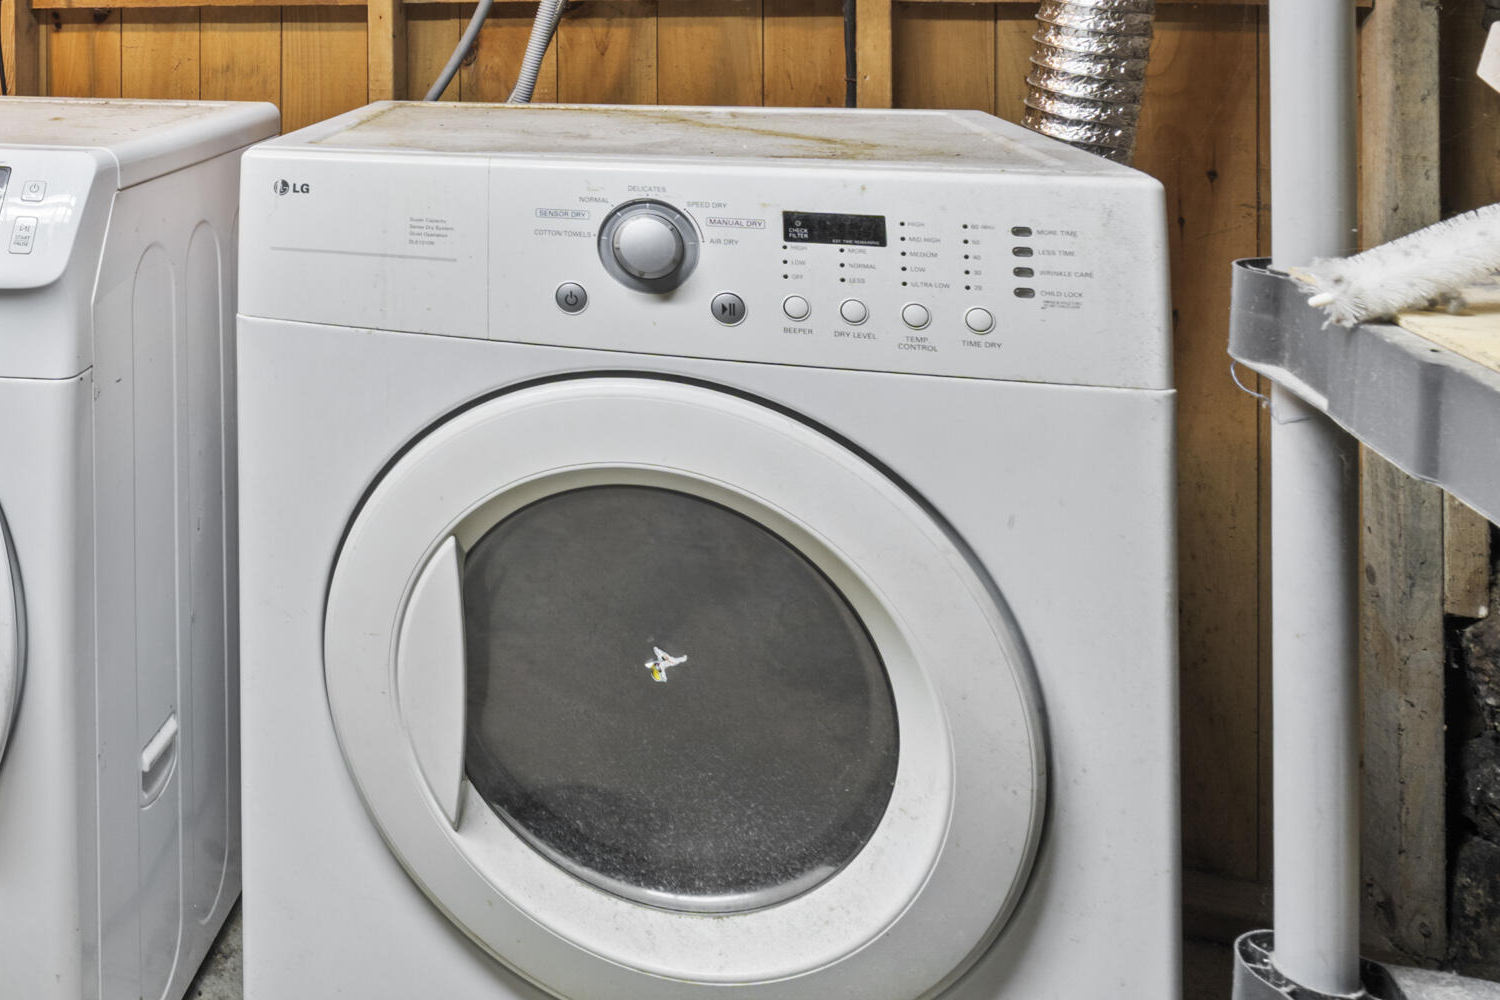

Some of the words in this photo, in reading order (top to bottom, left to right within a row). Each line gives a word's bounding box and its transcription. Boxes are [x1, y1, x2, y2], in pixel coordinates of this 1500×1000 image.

[292, 182, 310, 194] LG
[627, 185, 667, 194] DELICATES
[578, 195, 609, 204] NORMAL
[686, 201, 710, 209] SPEED
[711, 201, 728, 210] DRY
[539, 210, 569, 218] SENSOR
[570, 210, 587, 219] DRY
[708, 218, 745, 228] MANUAL
[746, 219, 763, 228] DRY
[534, 229, 592, 239] COTTON/TOWELS
[709, 238, 722, 246] AIR
[724, 238, 739, 246] DRY
[1039, 270, 1073, 278] WRINKLE
[1073, 271, 1094, 279] CARE
[910, 281, 934, 289] ULTRA
[1040, 290, 1064, 298] CHILD
[783, 327, 813, 336] BEEPER
[834, 331, 851, 339] DRY
[852, 331, 877, 340] LEVEL
[905, 335, 929, 344] TEMP
[962, 339, 983, 348] TIME
[983, 341, 1003, 349] DRY
[898, 343, 939, 353] CONTROL
